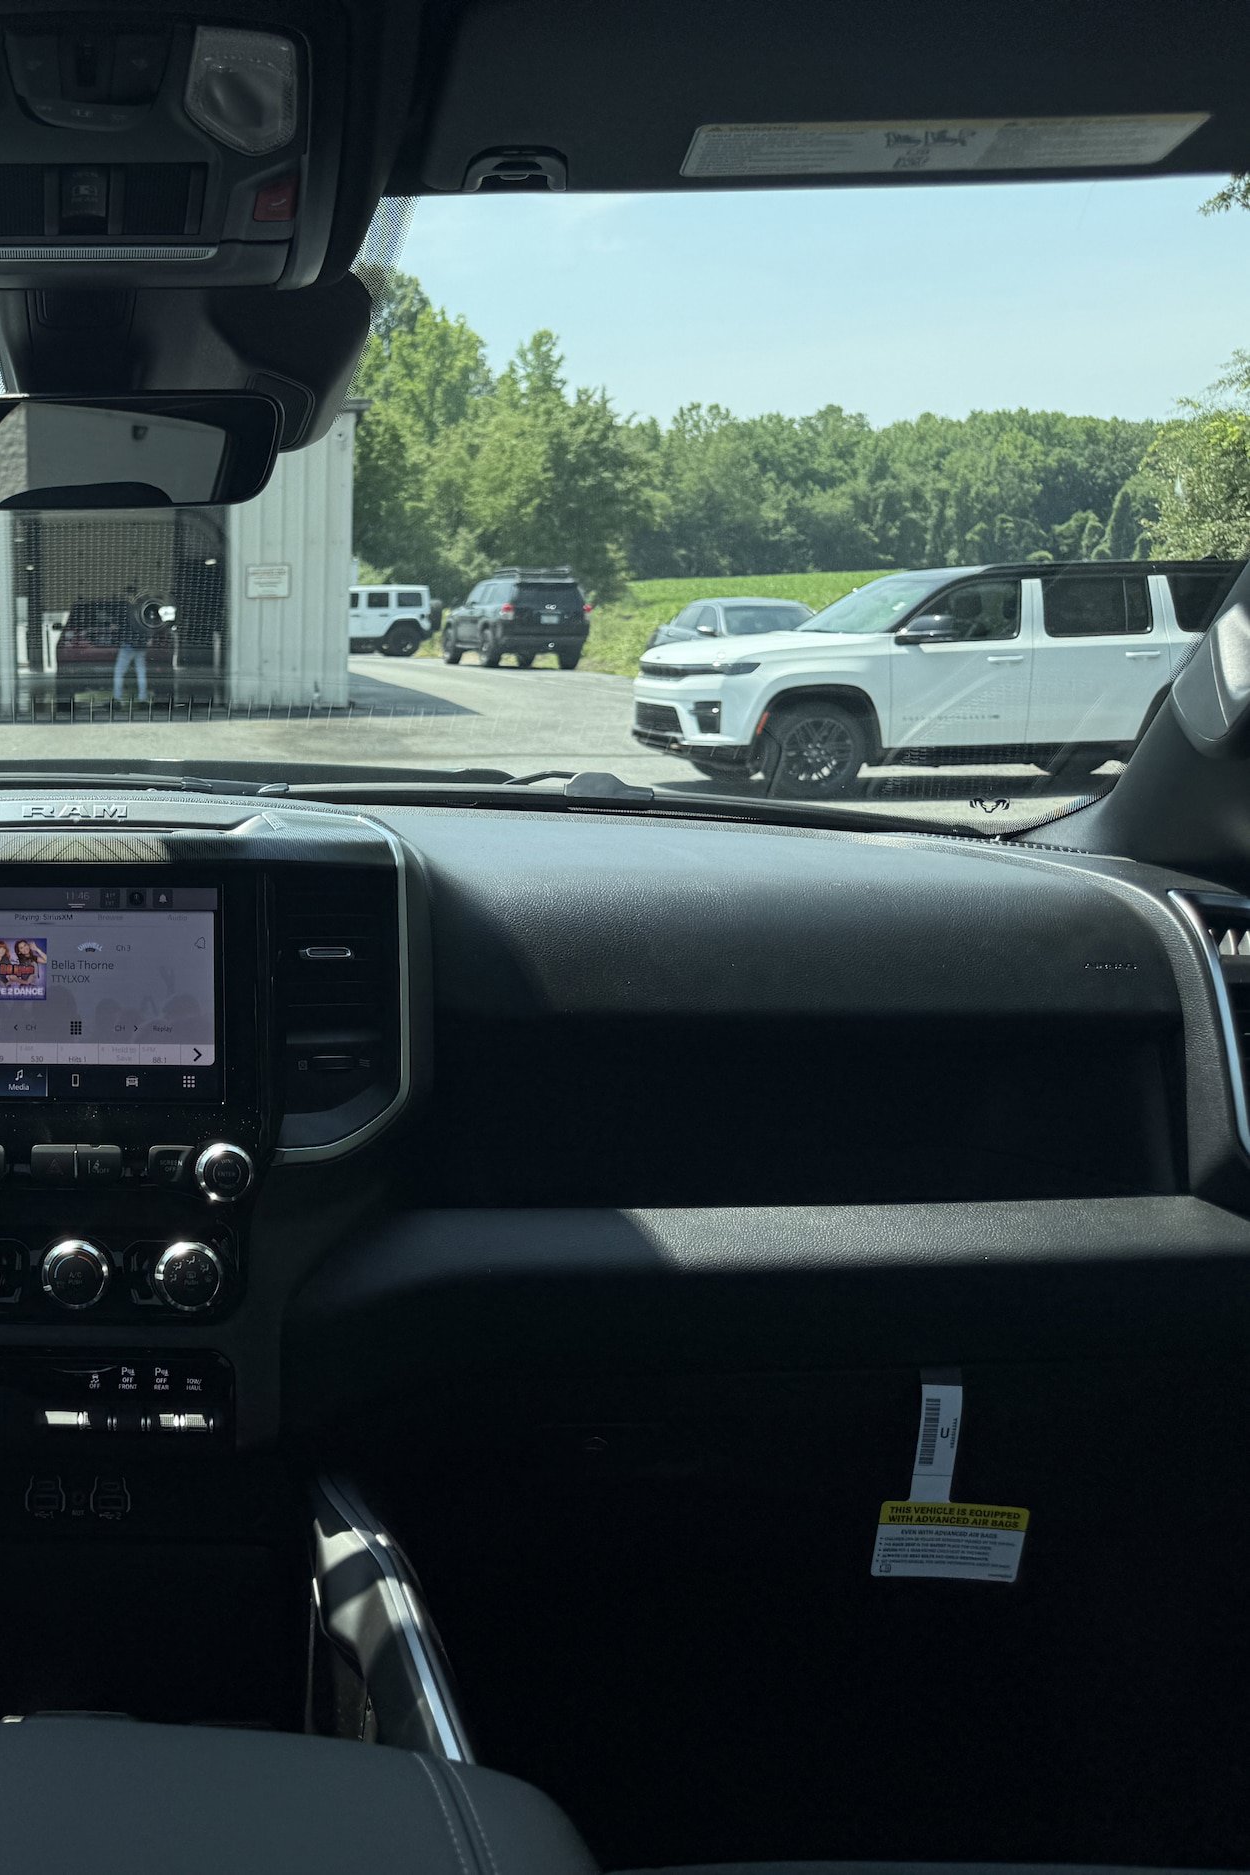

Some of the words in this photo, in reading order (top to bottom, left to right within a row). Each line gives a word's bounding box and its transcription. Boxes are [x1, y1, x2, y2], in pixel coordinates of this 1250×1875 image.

[23, 804, 128, 818] RAM
[167, 913, 188, 921] Audio
[51, 960, 76, 971] Bella
[76, 960, 115, 971] Thorne
[51, 974, 91, 984] TTYLXOX
[7, 987, 14, 996] 2
[14, 987, 44, 996] DANCE
[152, 1024, 173, 1034] Replay
[8, 1083, 30, 1091] Media
[159, 1159, 183, 1167] SCREEN
[69, 1271, 83, 1279] A/C
[889, 1506, 912, 1514] THIS
[913, 1507, 955, 1515] VEHICLE
[956, 1508, 967, 1516] IS
[969, 1509, 1021, 1520] EQUIPPED
[888, 1515, 913, 1523] WITH
[915, 1516, 969, 1525] ADVANCED
[971, 1518, 988, 1526] AIR
[990, 1520, 1019, 1528] BAGS
